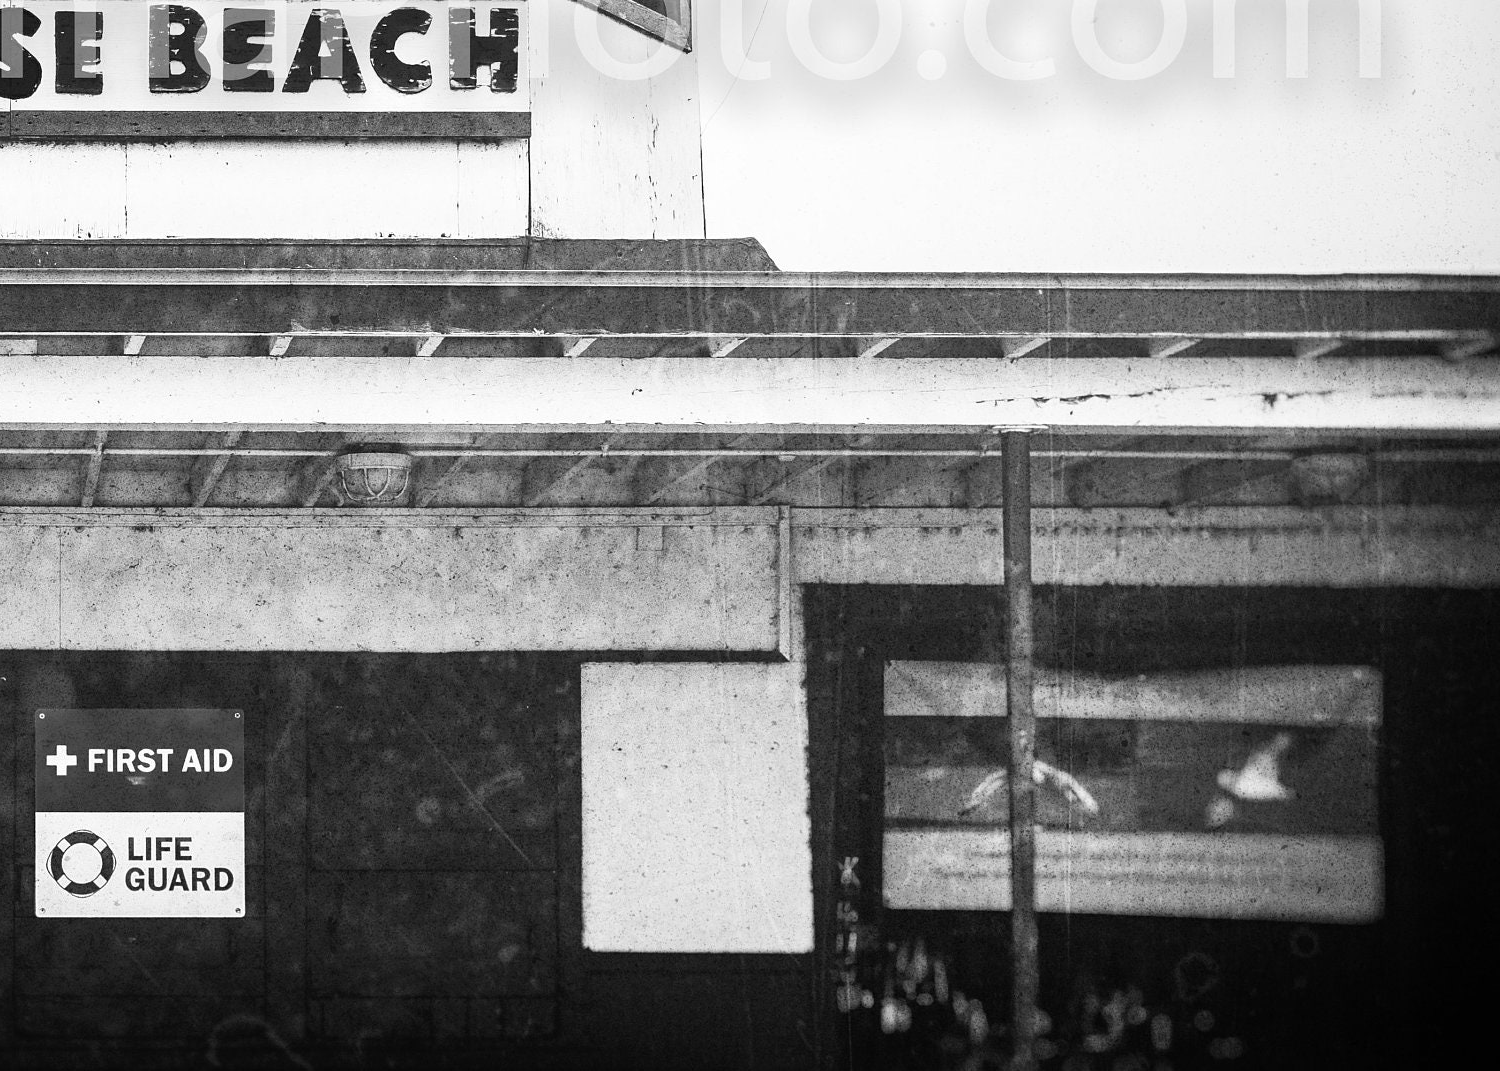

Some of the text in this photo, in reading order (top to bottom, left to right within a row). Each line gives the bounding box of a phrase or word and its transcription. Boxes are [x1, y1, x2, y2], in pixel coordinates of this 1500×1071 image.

[149, 6, 519, 94] BEACH
[88, 749, 234, 773] FIRST AID
[127, 837, 192, 861] LIFE
[125, 867, 234, 891] GUARD
